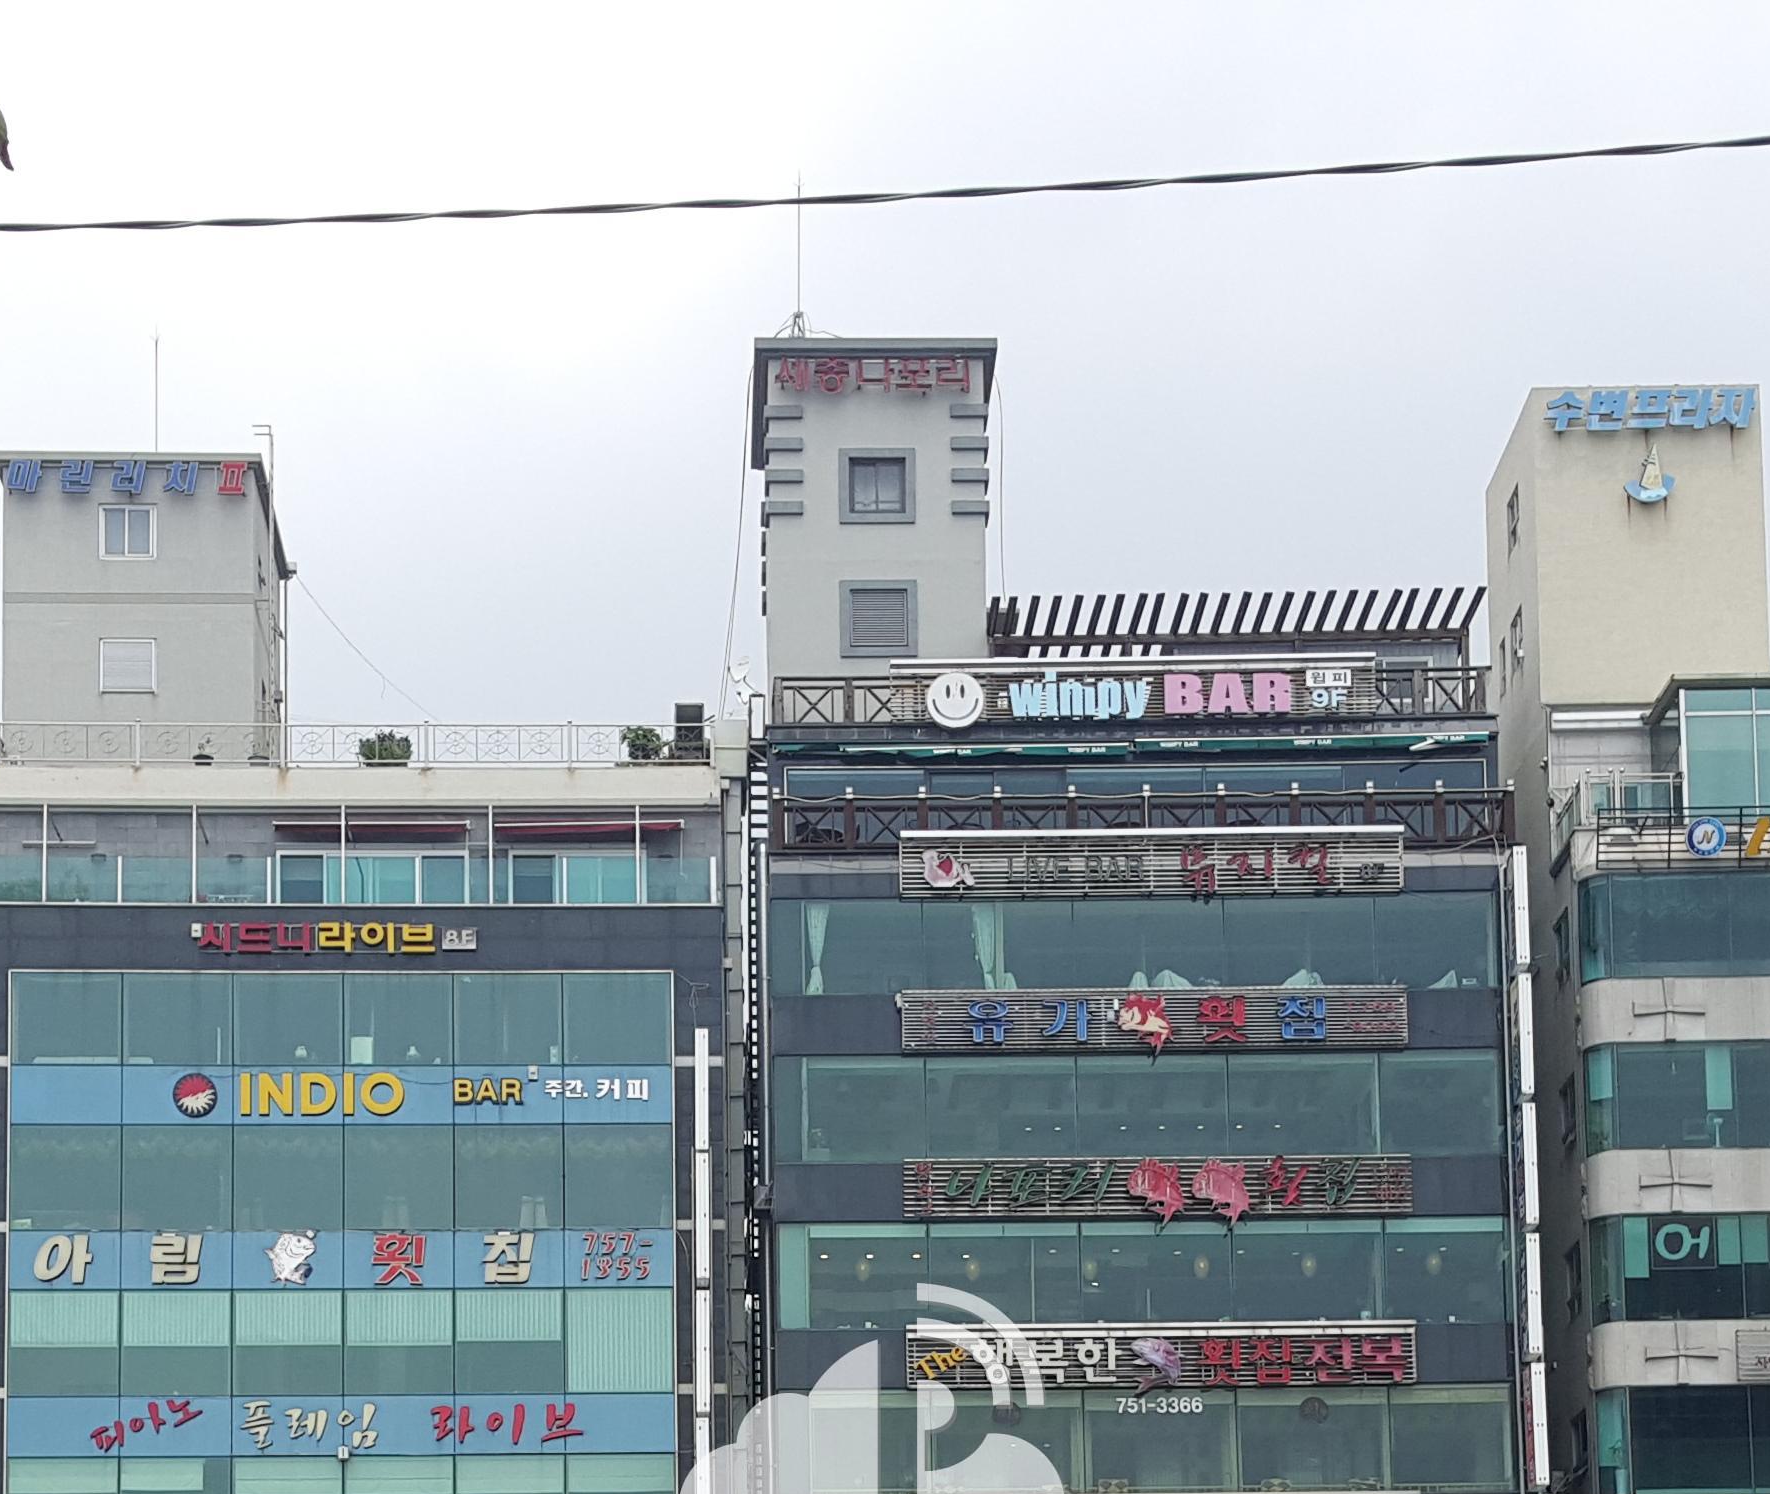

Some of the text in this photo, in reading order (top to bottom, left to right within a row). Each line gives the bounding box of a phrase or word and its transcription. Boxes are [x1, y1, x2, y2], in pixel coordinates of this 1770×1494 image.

[1544, 386, 1756, 433] 수변프라자
[6, 459, 199, 496] 마린리치
[1008, 671, 1291, 720] wimpy BAR
[1311, 688, 1347, 710] 9F
[318, 922, 438, 953] 라이브
[240, 1072, 523, 1117] INDIO BAR
[596, 1078, 649, 1101] 커피
[33, 1233, 533, 1286] 아림 횟집
[914, 1347, 967, 1380] The
[971, 1337, 1117, 1385] 행복한
[91, 1400, 204, 1451] 피아노
[432, 1404, 582, 1444] 라이브
[1116, 1398, 1203, 1414] 751-3366
